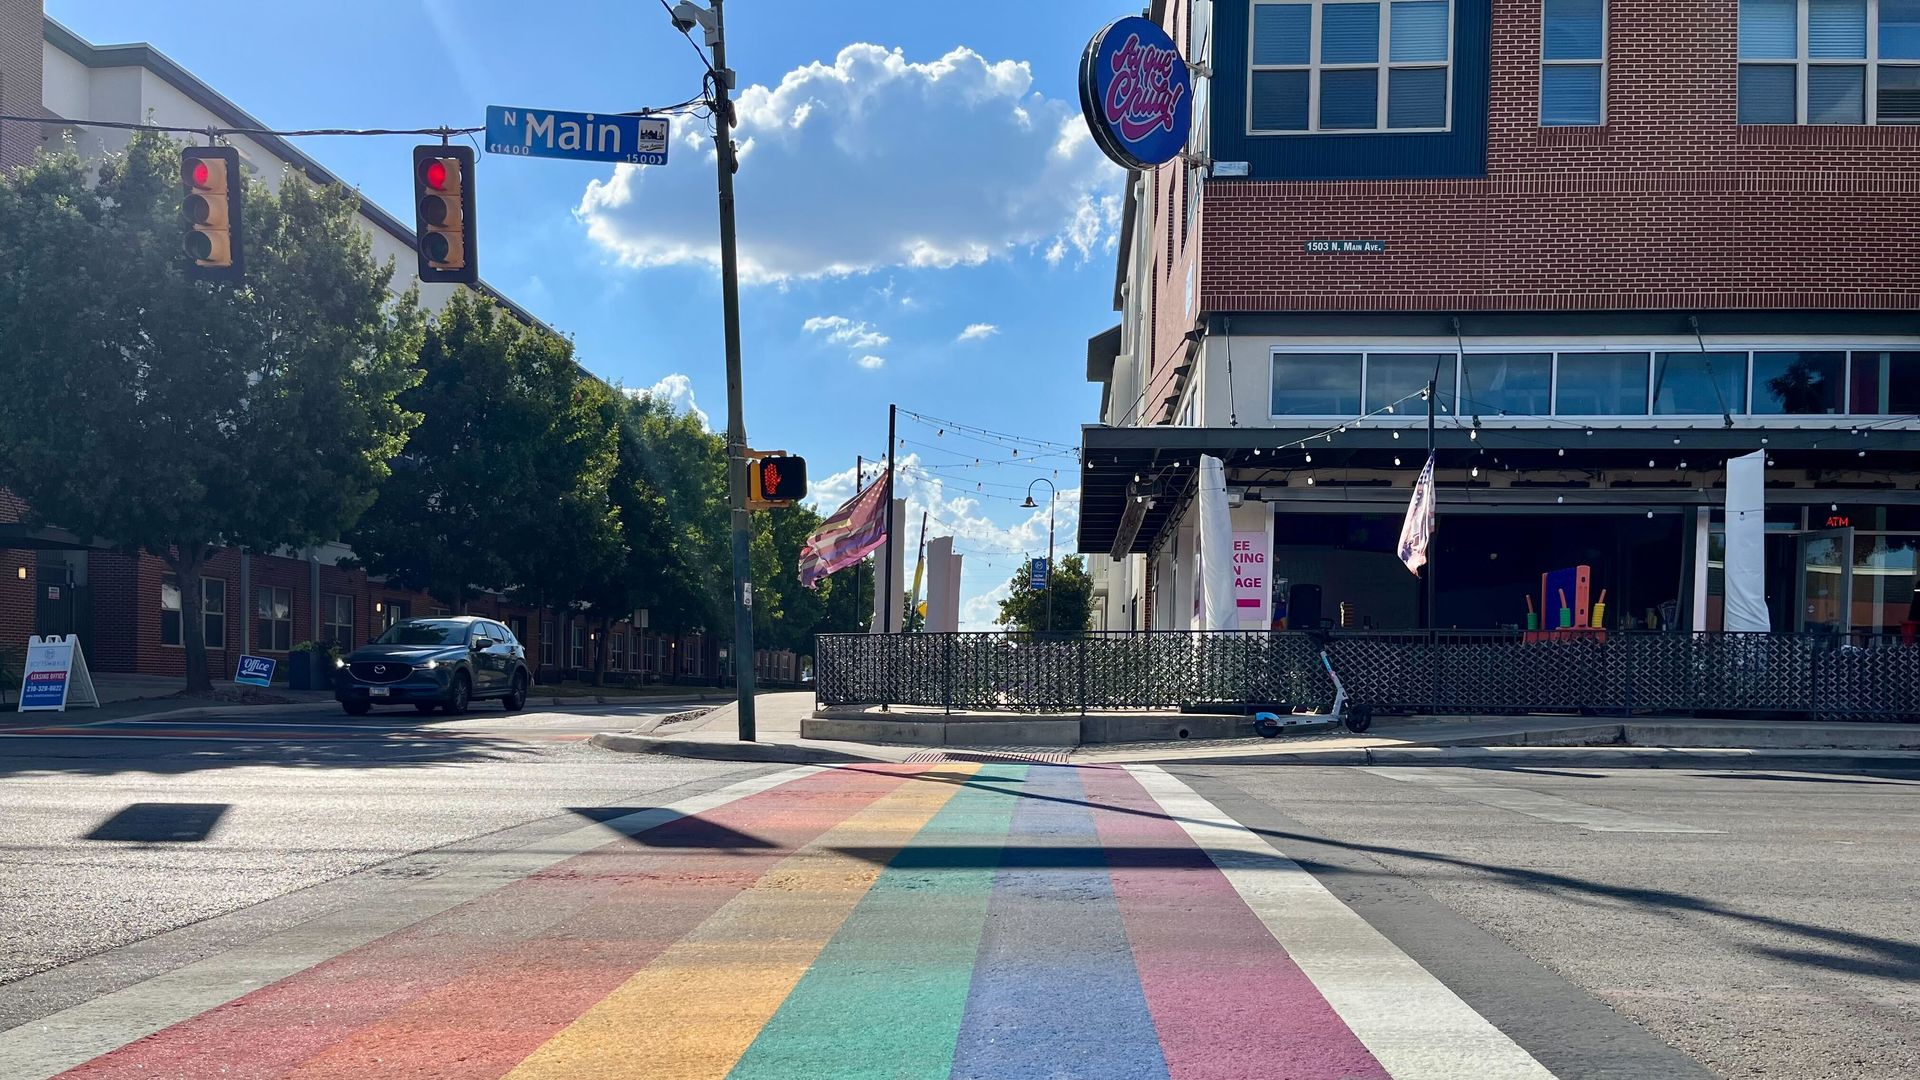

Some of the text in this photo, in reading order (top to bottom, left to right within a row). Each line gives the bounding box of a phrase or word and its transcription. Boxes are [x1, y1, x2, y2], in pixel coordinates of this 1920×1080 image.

[504, 111, 620, 152] N Main
[497, 144, 529, 155] 1400
[626, 153, 656, 164] 1500
[1307, 241, 1329, 251] 1503
[1331, 241, 1341, 251] N.
[1826, 516, 1849, 527] ATM
[244, 658, 270, 671] Office
